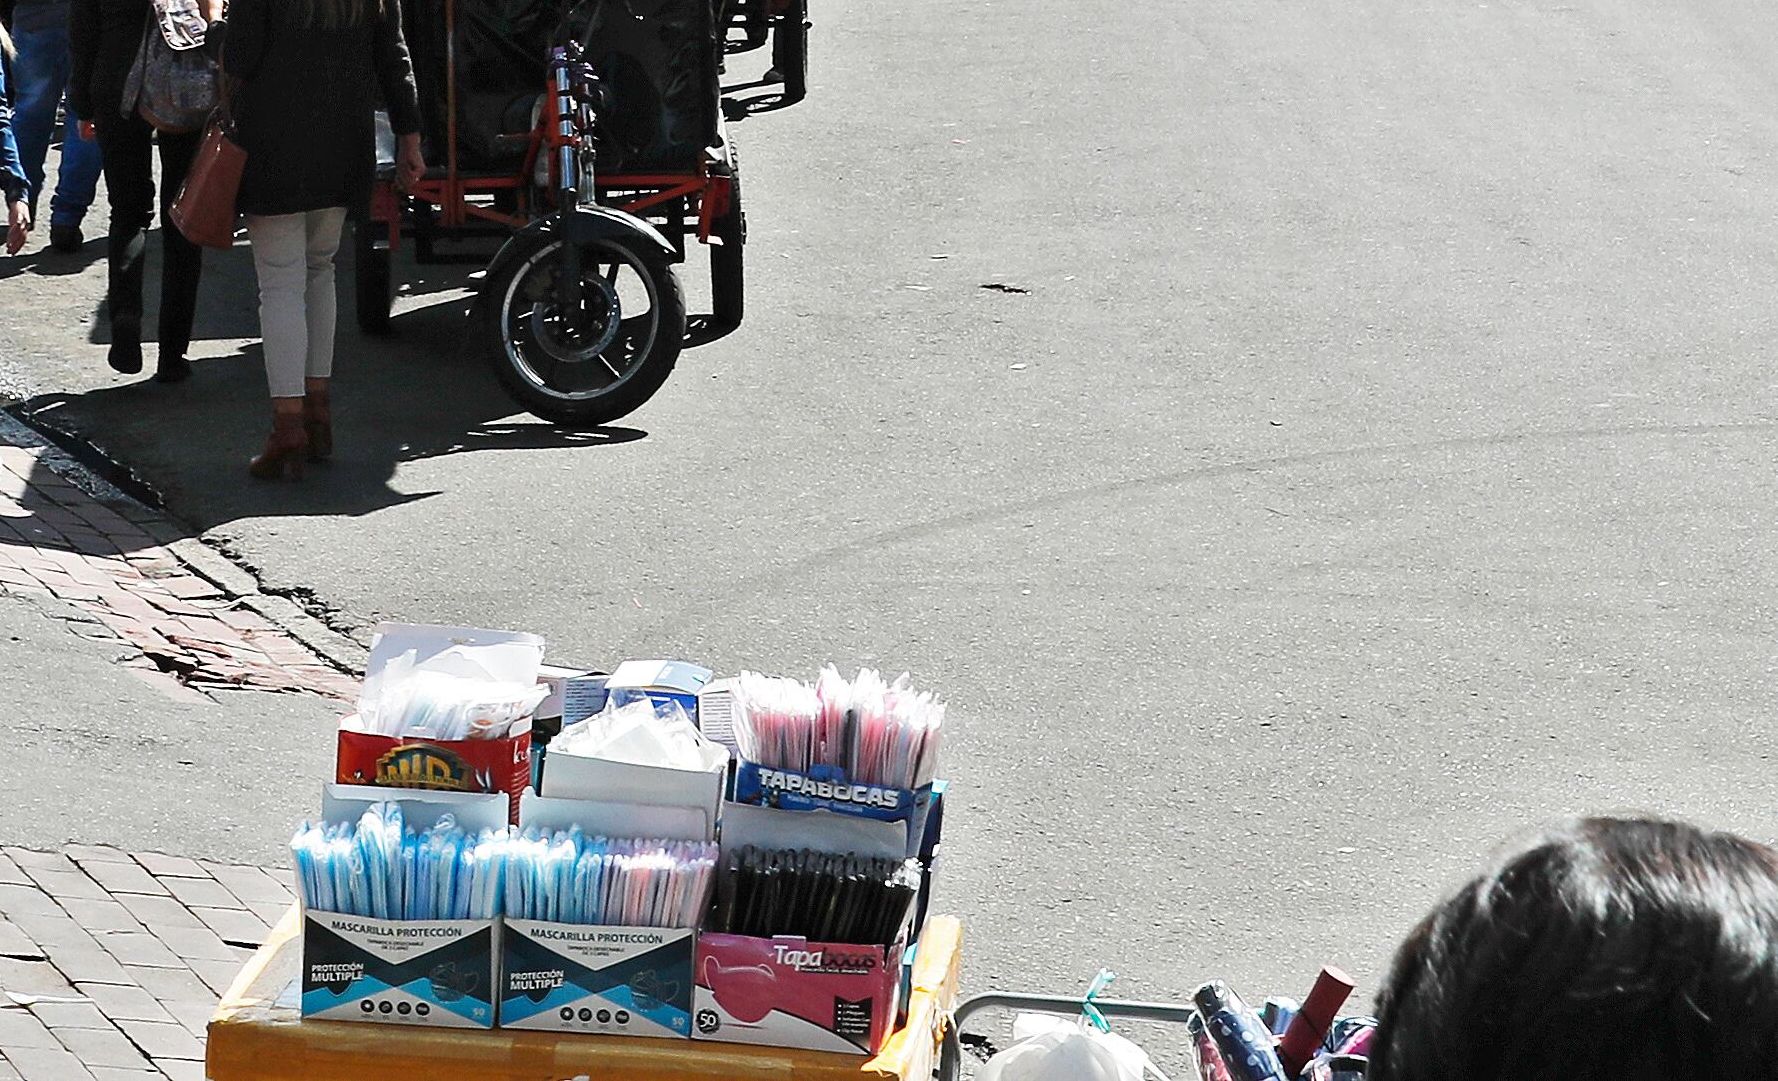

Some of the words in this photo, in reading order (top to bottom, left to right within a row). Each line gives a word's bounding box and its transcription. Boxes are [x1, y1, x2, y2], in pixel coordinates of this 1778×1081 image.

[758, 768, 900, 809] TAPABOCAS
[332, 921, 394, 937] MASCARILLA
[397, 926, 463, 938] PROTECCIÓN
[531, 928, 595, 942] MASCARILLA
[597, 933, 663, 945] PROTECCIÓN
[311, 963, 364, 973] PROTECCIÓN
[311, 972, 364, 983] MULTIPLE
[510, 970, 564, 980] PROTECCIÓN
[510, 978, 564, 990] MULTIPLE
[700, 1013, 717, 1026] 50
